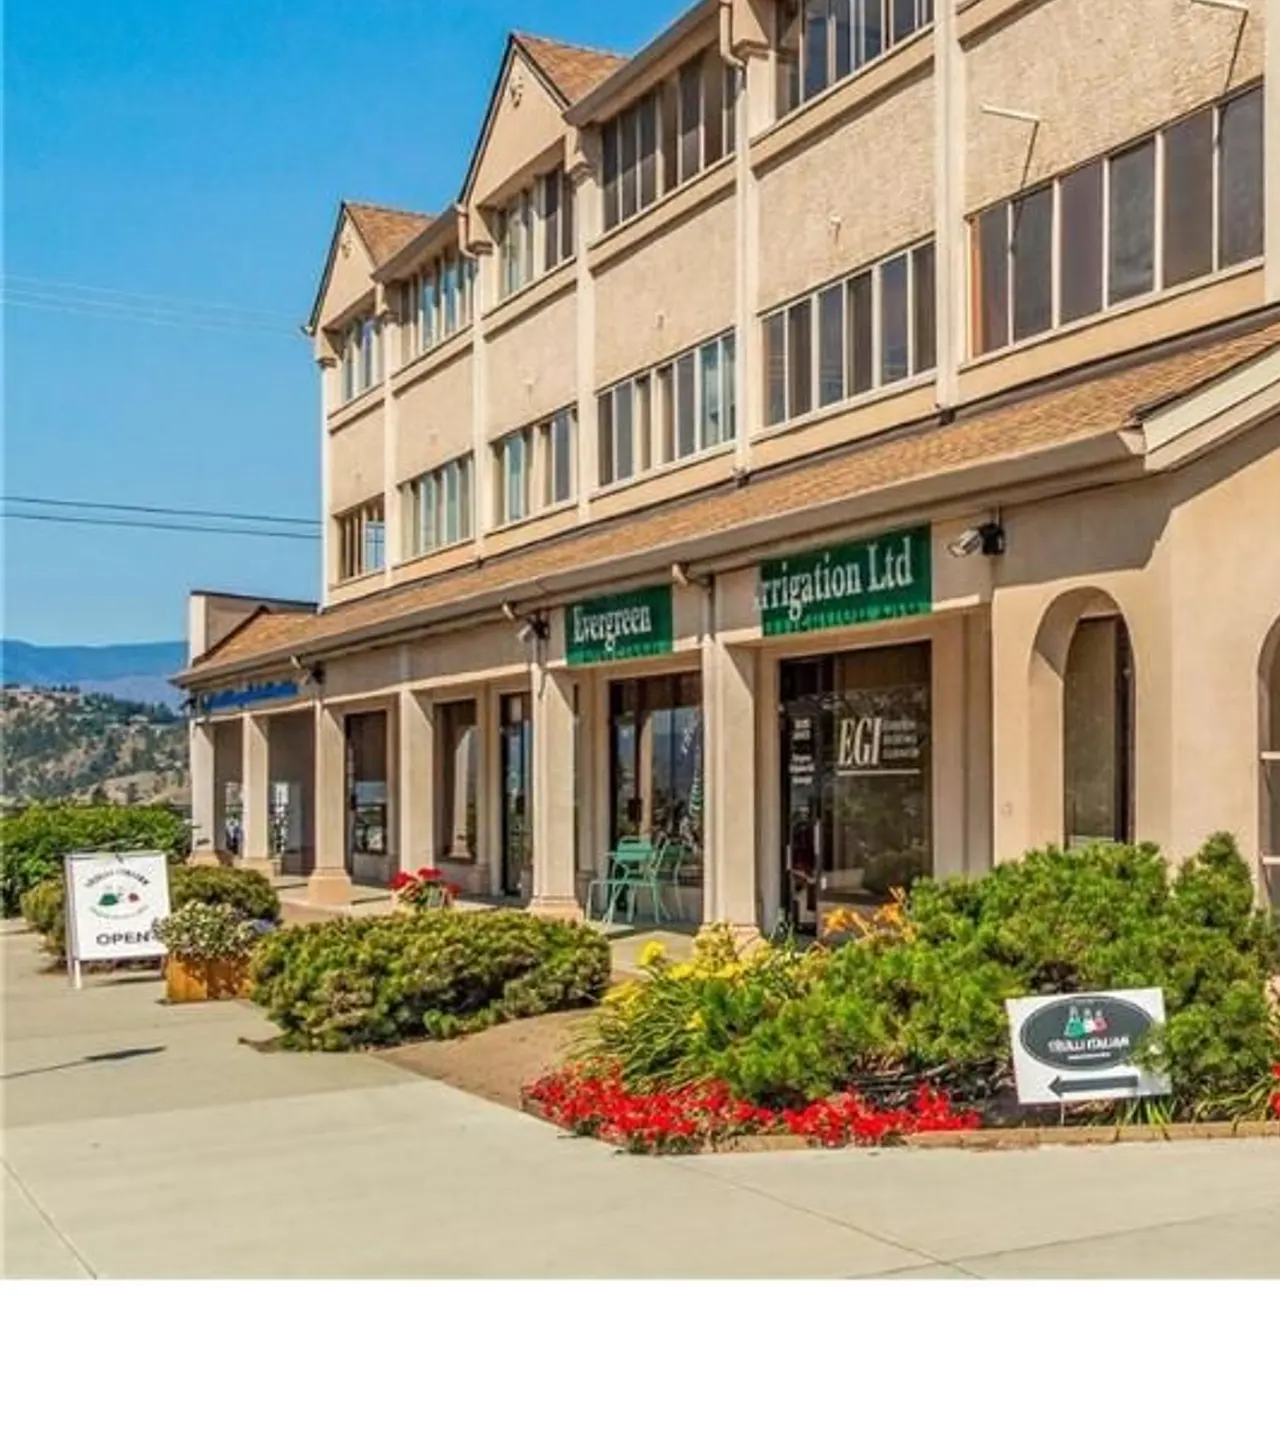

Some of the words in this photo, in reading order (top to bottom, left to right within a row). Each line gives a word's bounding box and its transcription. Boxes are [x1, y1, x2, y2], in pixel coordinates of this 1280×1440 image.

[867, 535, 914, 592] Ltd
[573, 605, 652, 652] Evergreen
[838, 717, 882, 766] EGI
[96, 931, 150, 946] OPEN
